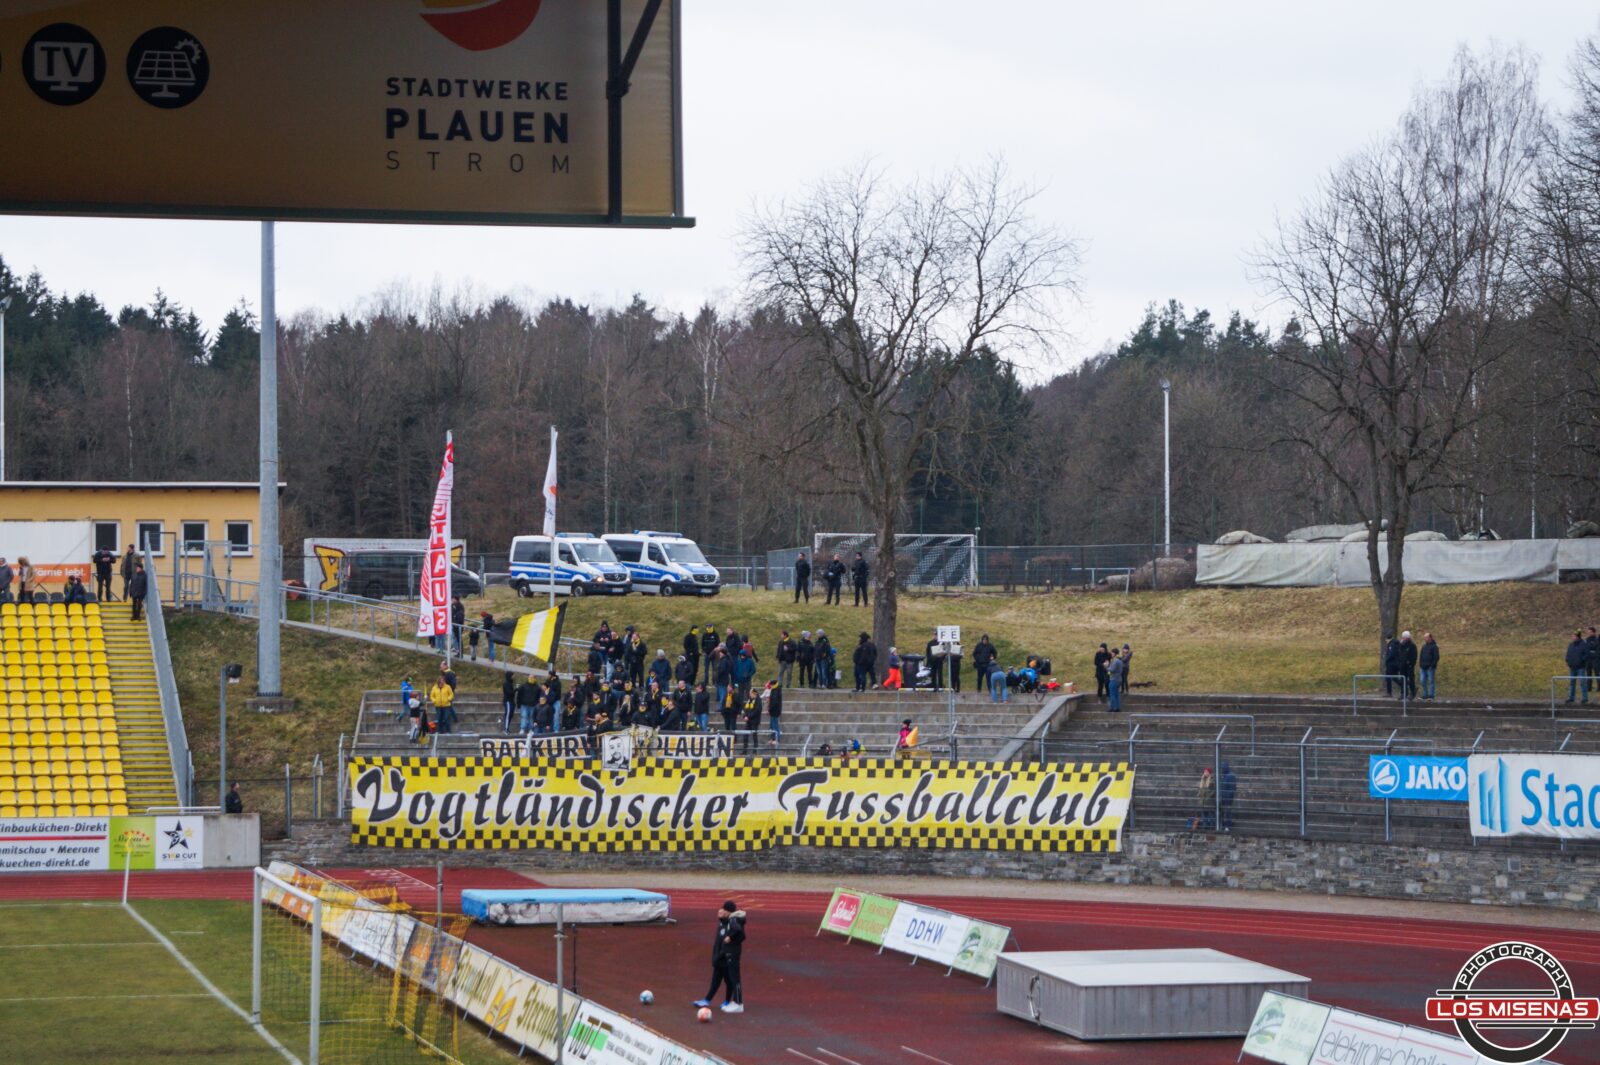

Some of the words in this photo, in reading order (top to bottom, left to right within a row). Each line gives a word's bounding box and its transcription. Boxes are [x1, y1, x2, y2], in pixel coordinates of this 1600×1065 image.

[40, 46, 88, 77] TV
[386, 77, 568, 100] STADTWERKE
[386, 108, 568, 143] PLAUEN
[386, 151, 569, 173] STROM
[35, 567, 62, 577] ärme
[1405, 765, 1467, 791] JAKO
[357, 767, 748, 839] Vogtländischer
[778, 769, 1113, 835] Fussballclub
[0, 822, 107, 833] inbauküchen-Direkt
[57, 845, 100, 854] Meerane
[906, 917, 948, 945] DDHW
